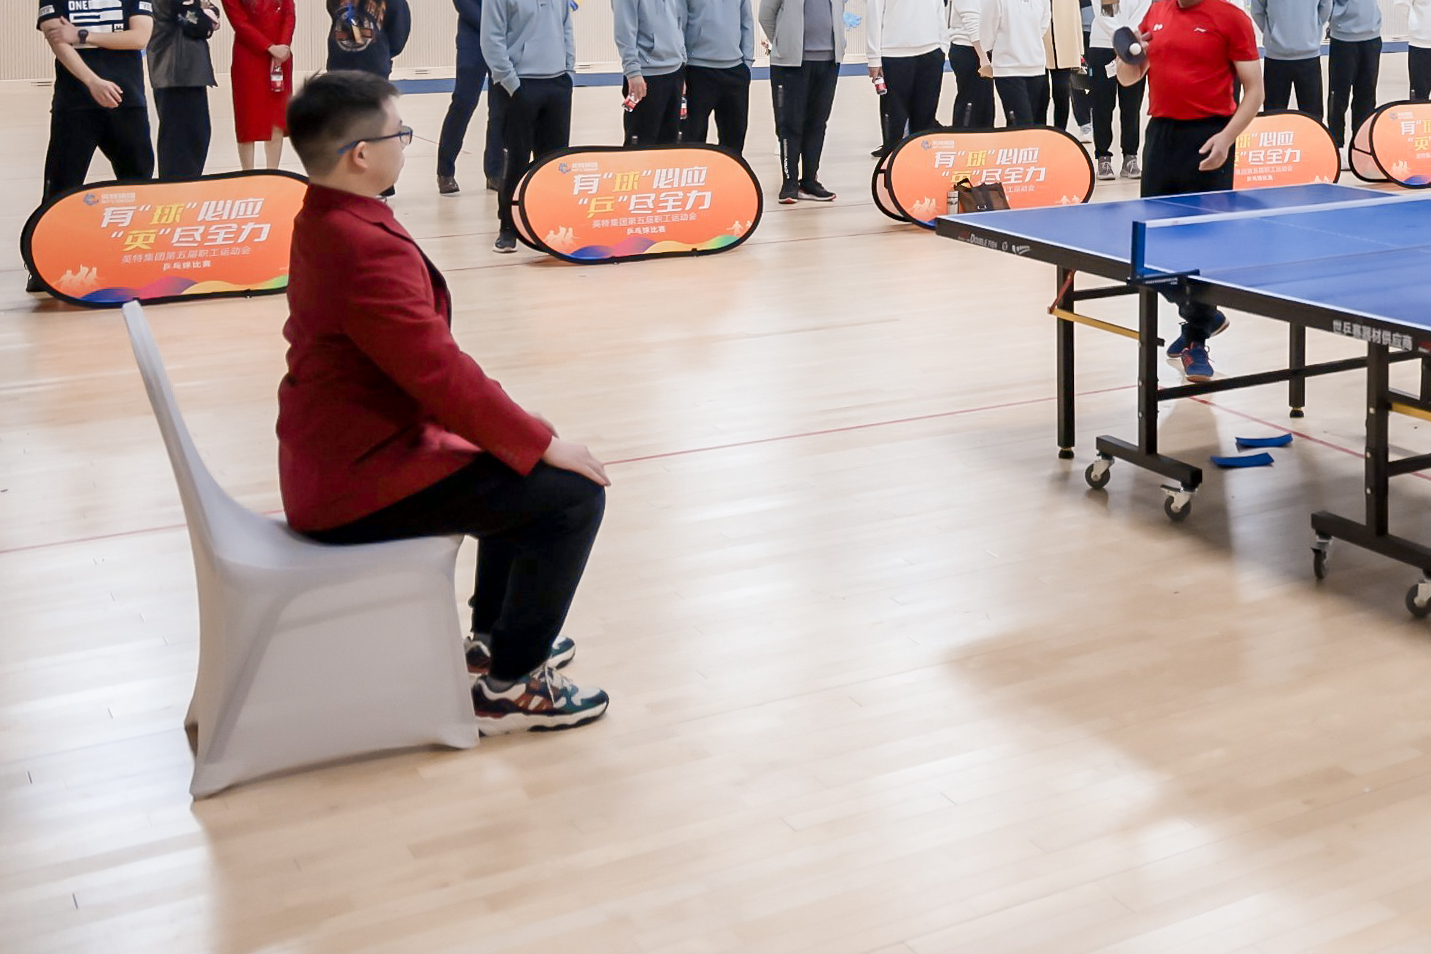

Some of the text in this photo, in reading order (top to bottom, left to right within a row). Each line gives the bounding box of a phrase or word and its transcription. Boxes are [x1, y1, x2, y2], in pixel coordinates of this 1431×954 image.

[68, 0, 89, 11] ONE
[1332, 319, 1413, 351] 世乒赛器材供应商
